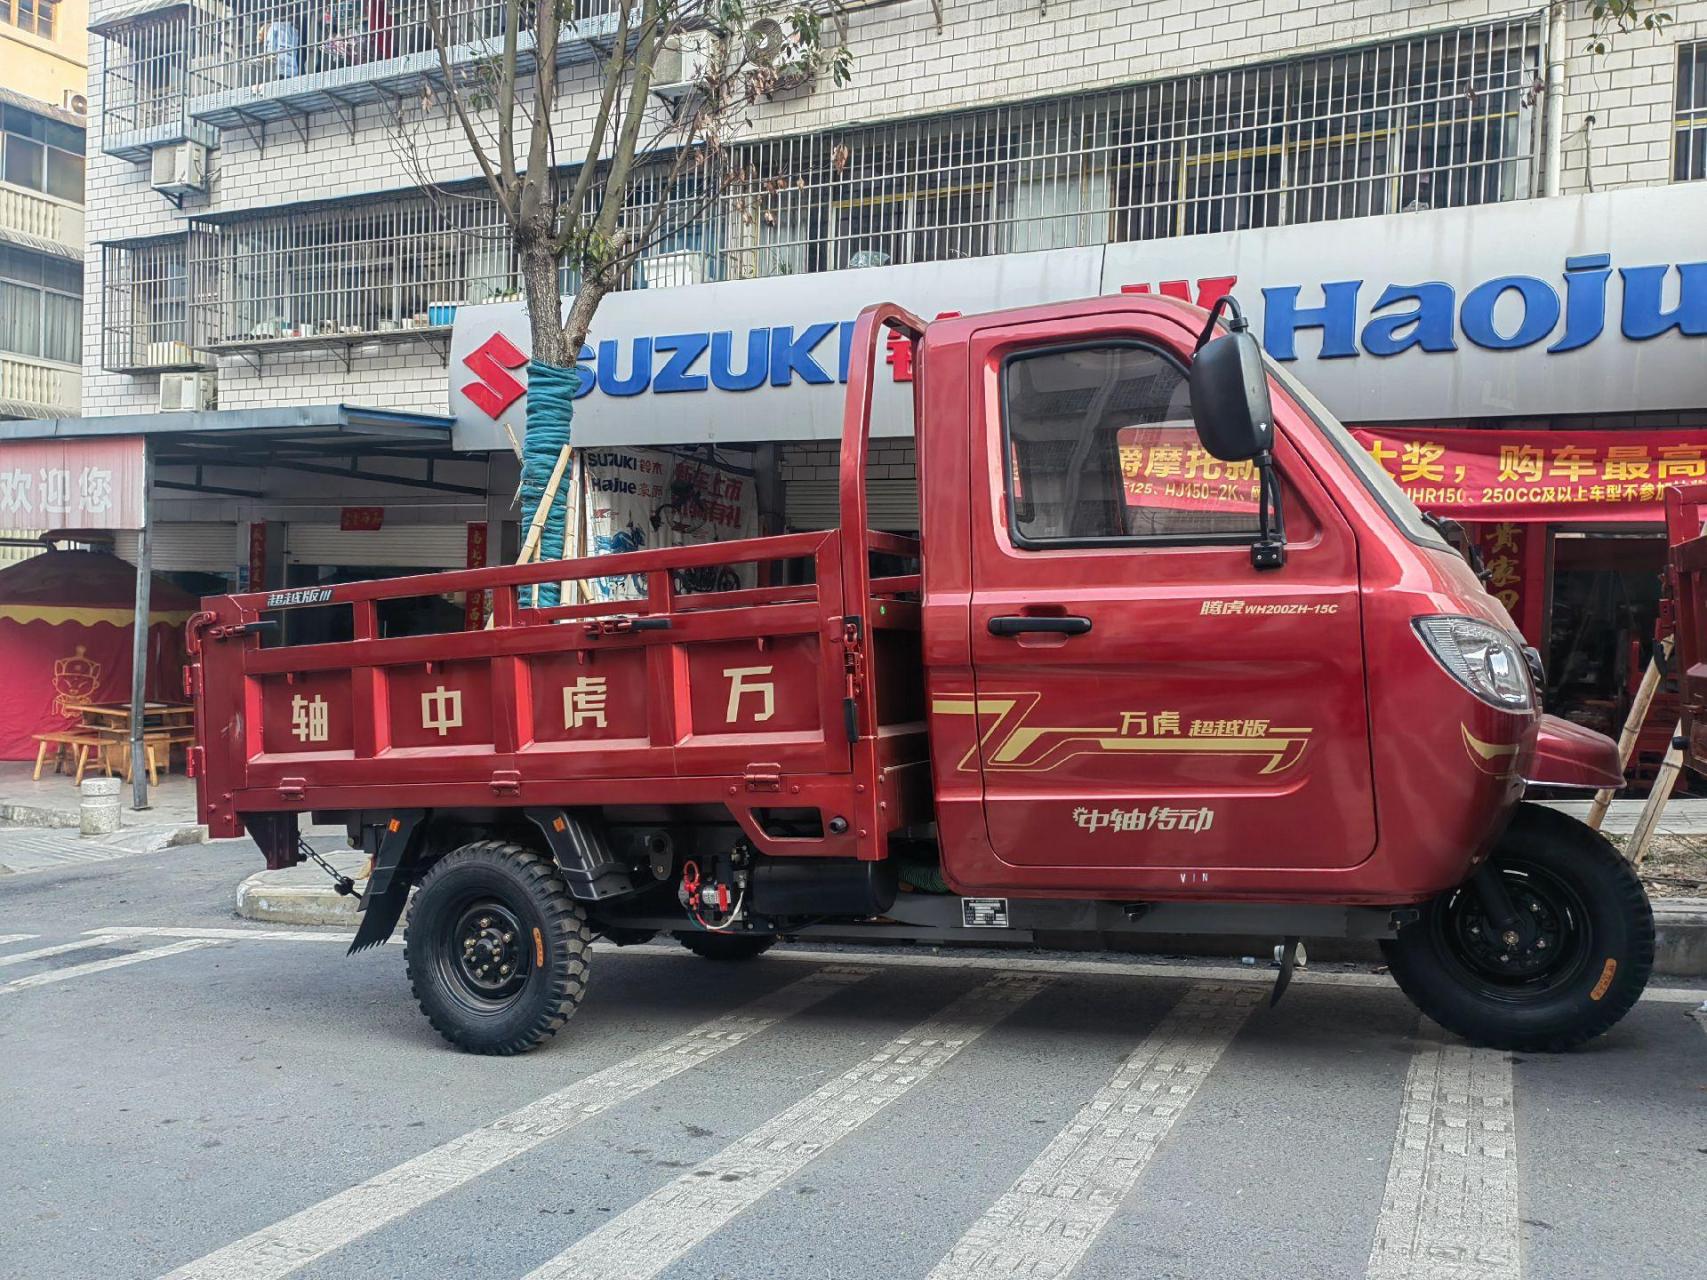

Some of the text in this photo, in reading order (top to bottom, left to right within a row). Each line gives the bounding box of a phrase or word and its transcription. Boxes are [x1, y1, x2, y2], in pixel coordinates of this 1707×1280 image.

[587, 452, 637, 471] SUZUKI
[0, 466, 112, 513] 欢迎您
[1245, 604, 1338, 615] WH200ZH-15C
[291, 666, 775, 742] 轴 中 虎 万
[1119, 711, 1271, 738] 万虎 超越版
[1075, 806, 1214, 834] 中轴传动
